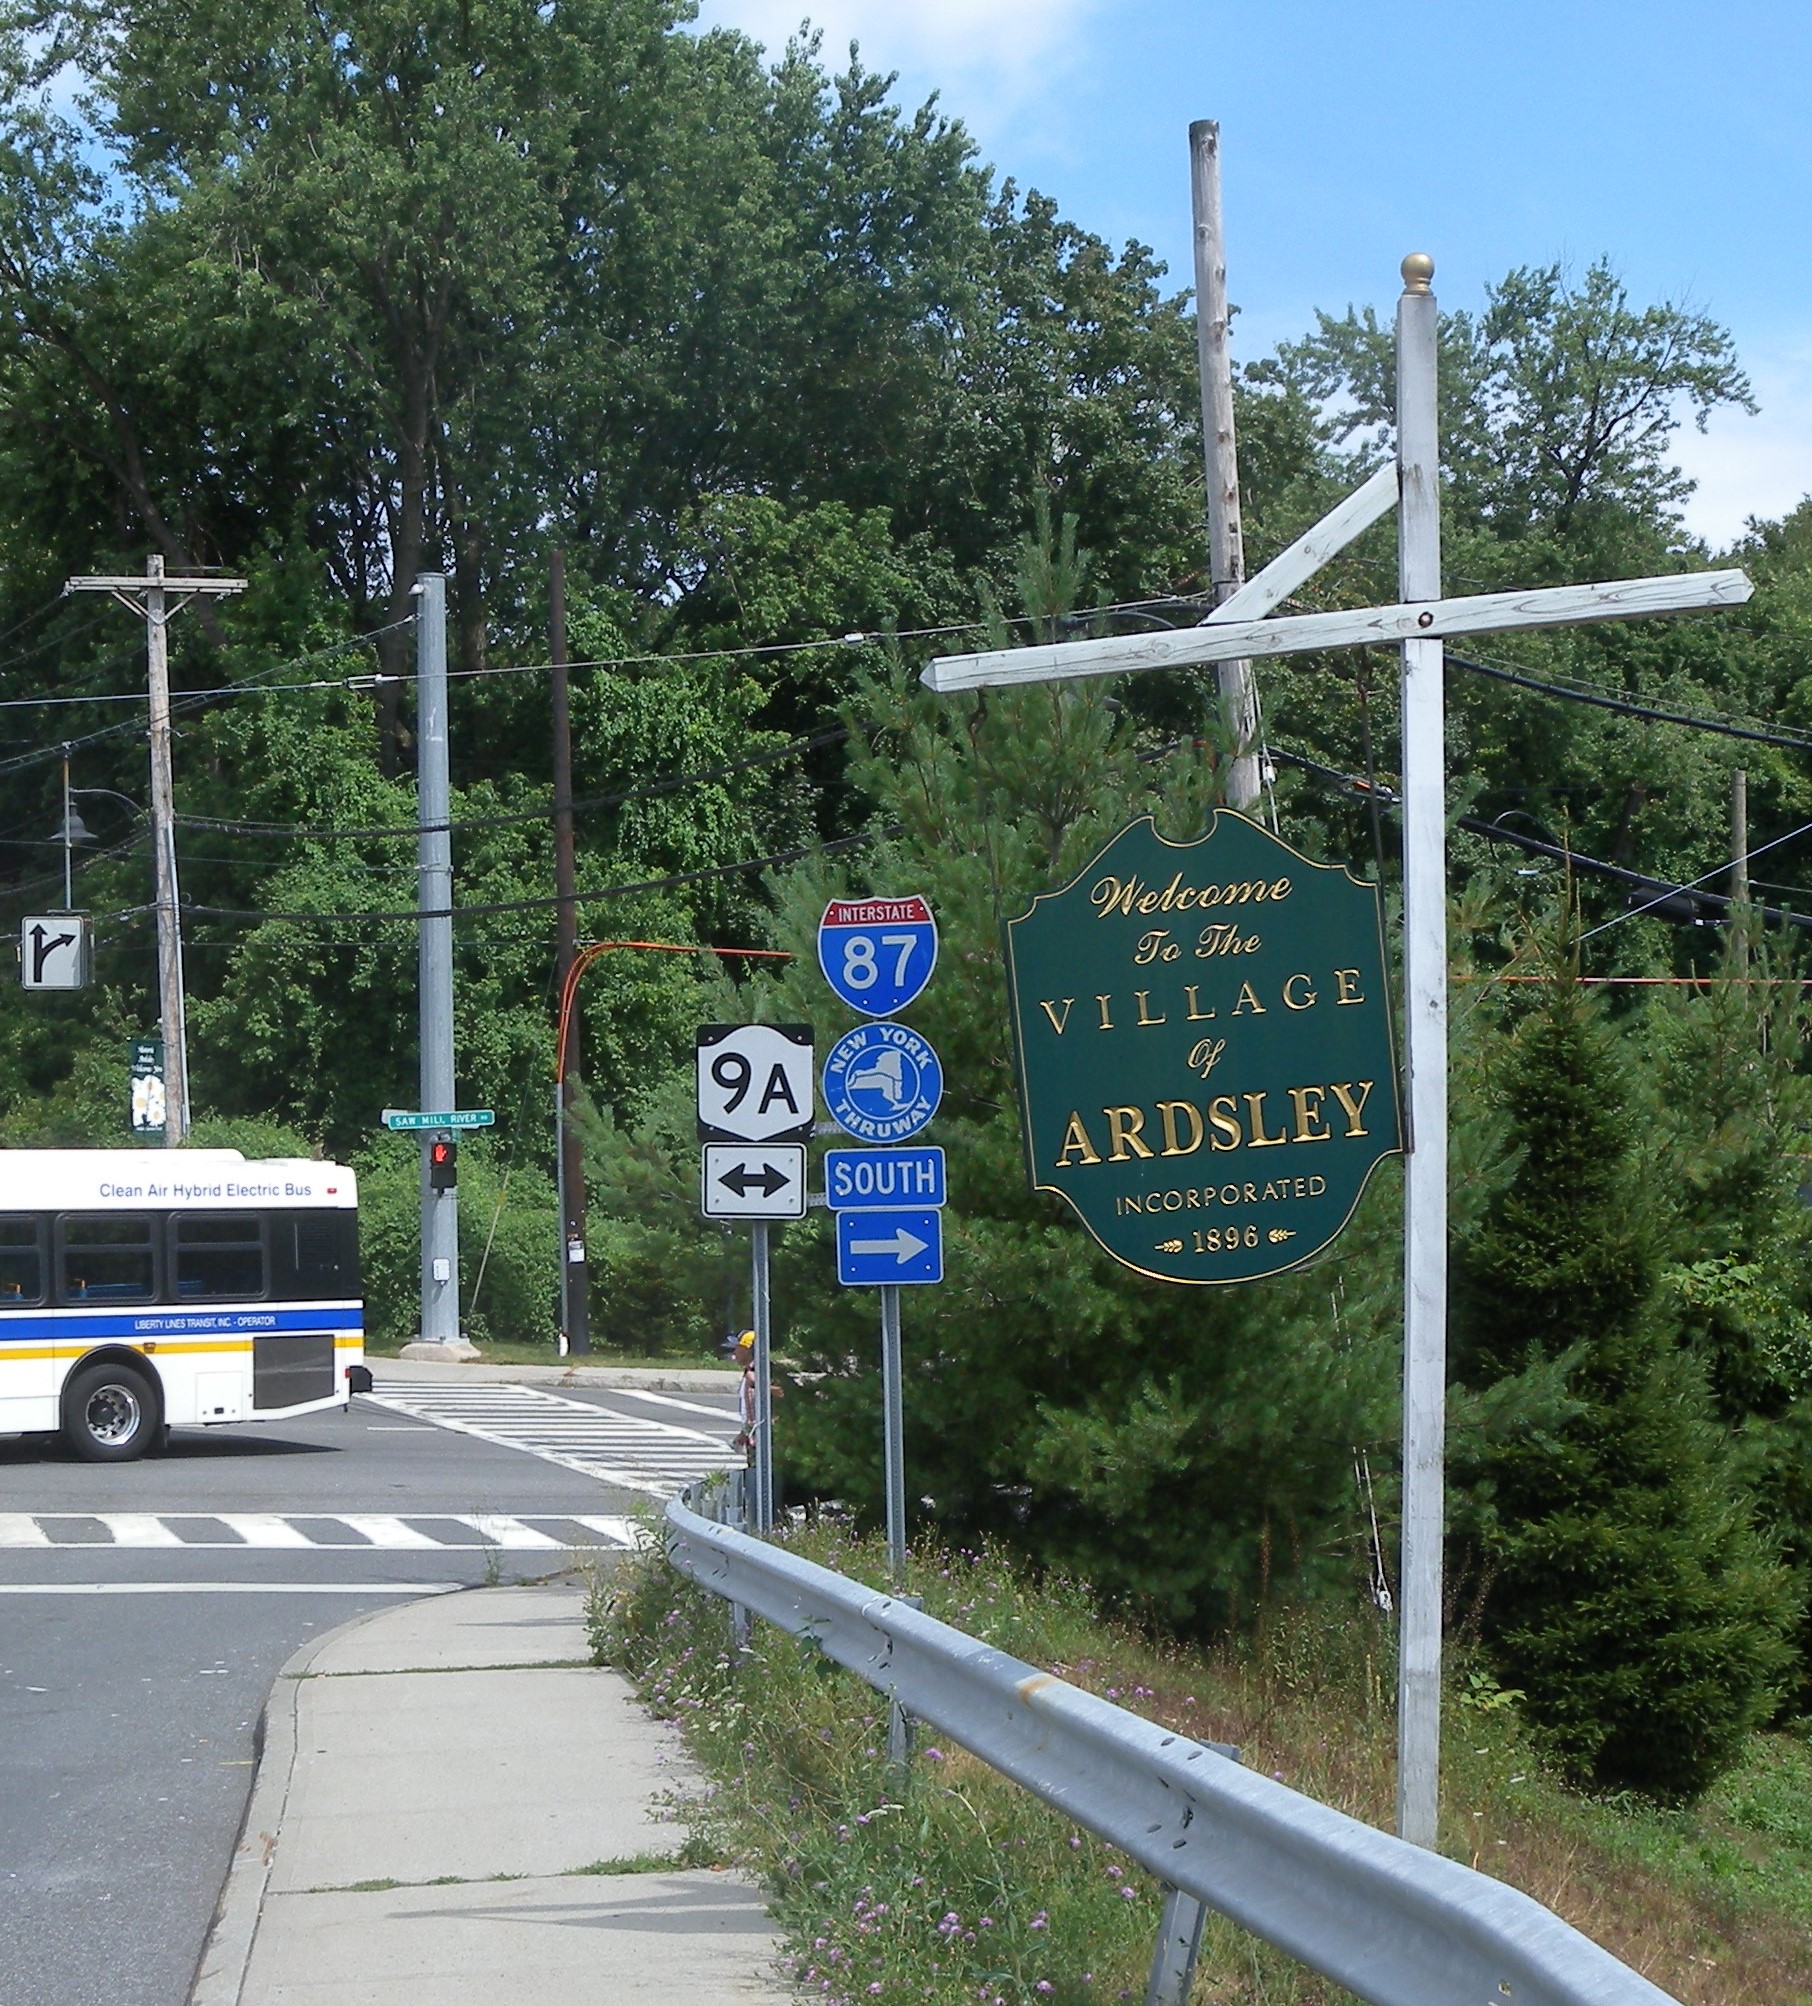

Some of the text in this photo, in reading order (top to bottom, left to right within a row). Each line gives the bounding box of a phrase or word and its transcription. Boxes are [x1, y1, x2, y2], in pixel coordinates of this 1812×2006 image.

[838, 905, 915, 923] INTERSTATE
[1090, 872, 1293, 919] Welcome
[842, 934, 918, 991] 87
[1133, 923, 1262, 965] To The
[1040, 968, 1366, 1035] VILLAGE
[830, 1027, 933, 1074] NEW YORK
[1186, 1038, 1227, 1079] Of
[711, 1052, 799, 1115] 9A
[395, 1116, 416, 1127] SAW
[421, 1115, 446, 1125] MILL
[450, 1113, 477, 1124] RIVER
[834, 1095, 932, 1138] THRUWAY
[1055, 1080, 1375, 1167] ARDSLEY
[99, 1182, 312, 1200] Clean Air Hybrid Electric Bus
[834, 1159, 936, 1196] SOUTH
[1116, 1175, 1327, 1216] INCORPORATED
[1192, 1225, 1259, 1254] 1896
[134, 1319, 164, 1330] LIBERTY
[165, 1318, 186, 1329] LINES
[237, 1315, 276, 1327] OPERATOR
